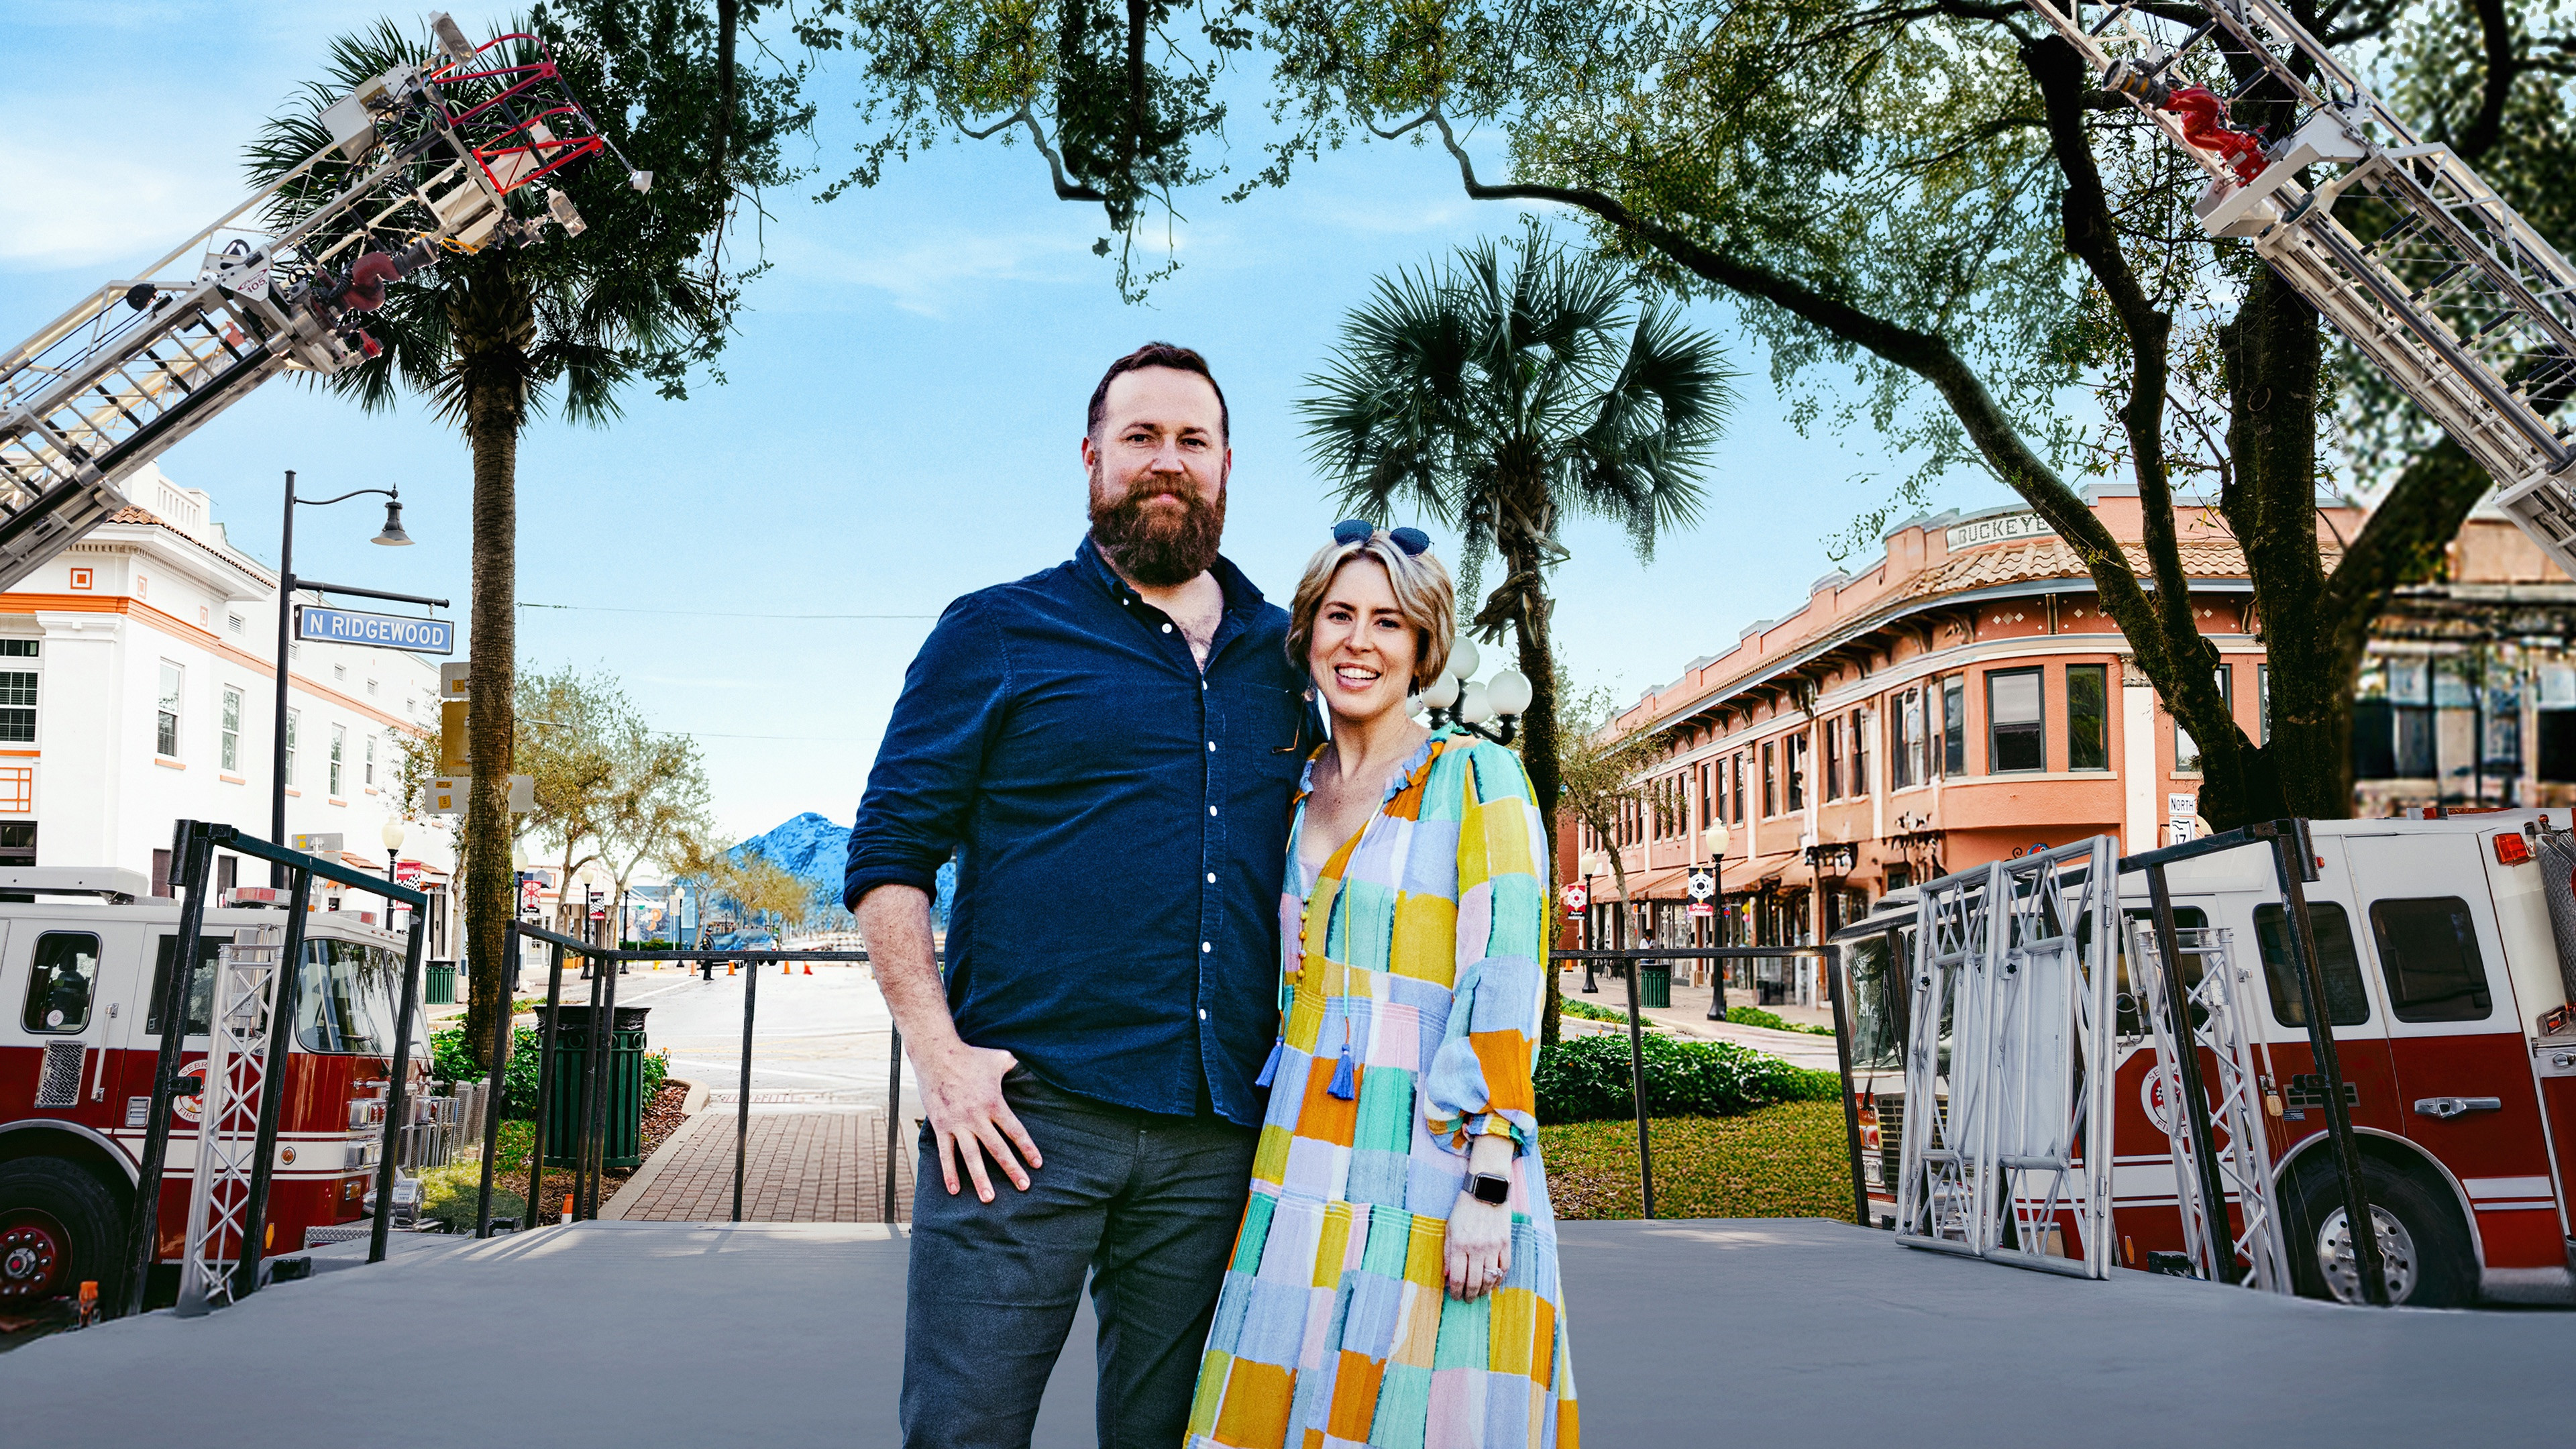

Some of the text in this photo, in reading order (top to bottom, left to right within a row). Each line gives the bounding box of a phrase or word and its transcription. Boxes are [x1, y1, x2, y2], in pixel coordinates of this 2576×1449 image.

[1958, 516, 2049, 543] BUCKEYE
[310, 613, 444, 646] N RIDGEWOOD
[2171, 798, 2194, 811] NORTH
[2176, 834, 2186, 845] 17
[181, 1061, 207, 1075] SEBR
[178, 1107, 198, 1120] FIRE
